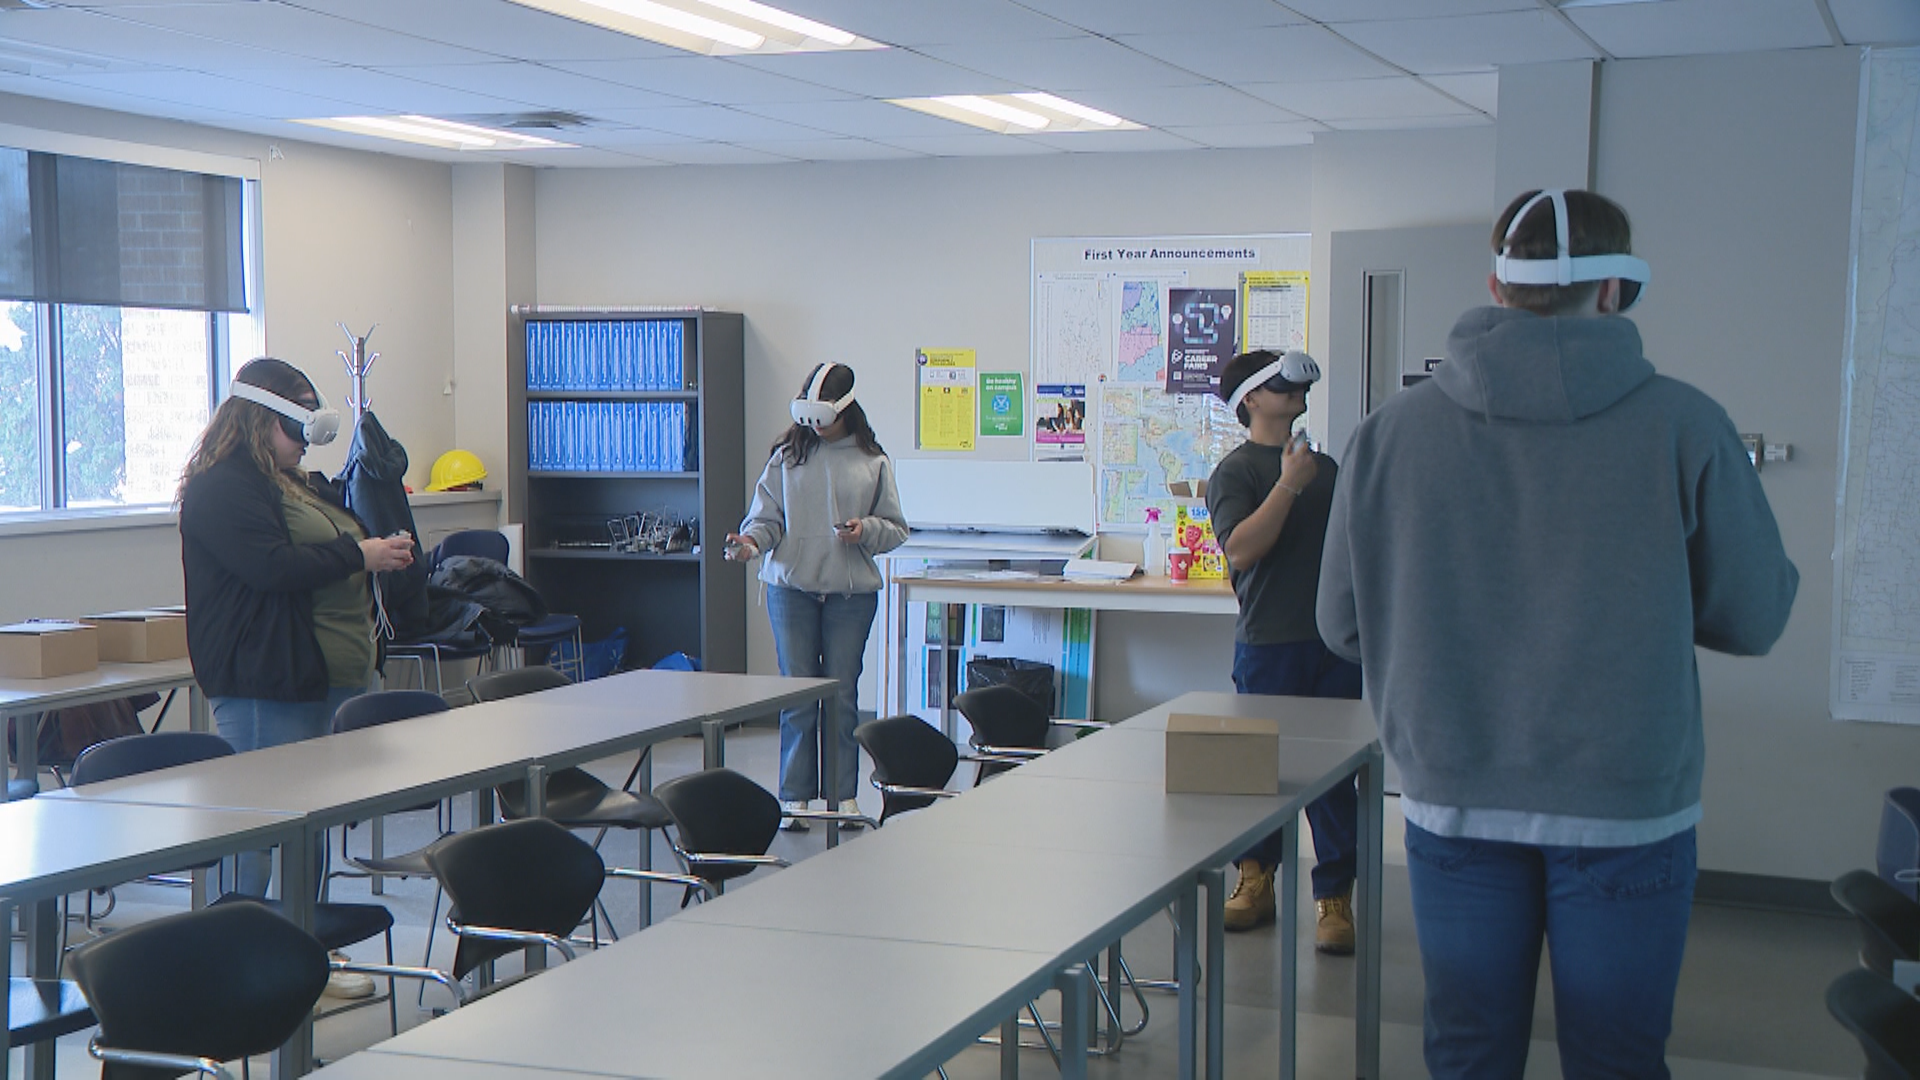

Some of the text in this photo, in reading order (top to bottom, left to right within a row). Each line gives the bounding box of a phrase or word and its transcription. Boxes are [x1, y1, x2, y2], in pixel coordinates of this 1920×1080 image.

[1084, 249, 1255, 260] First Year Announcements
[1184, 355, 1218, 363] CAREER
[1192, 507, 1208, 516] 150
